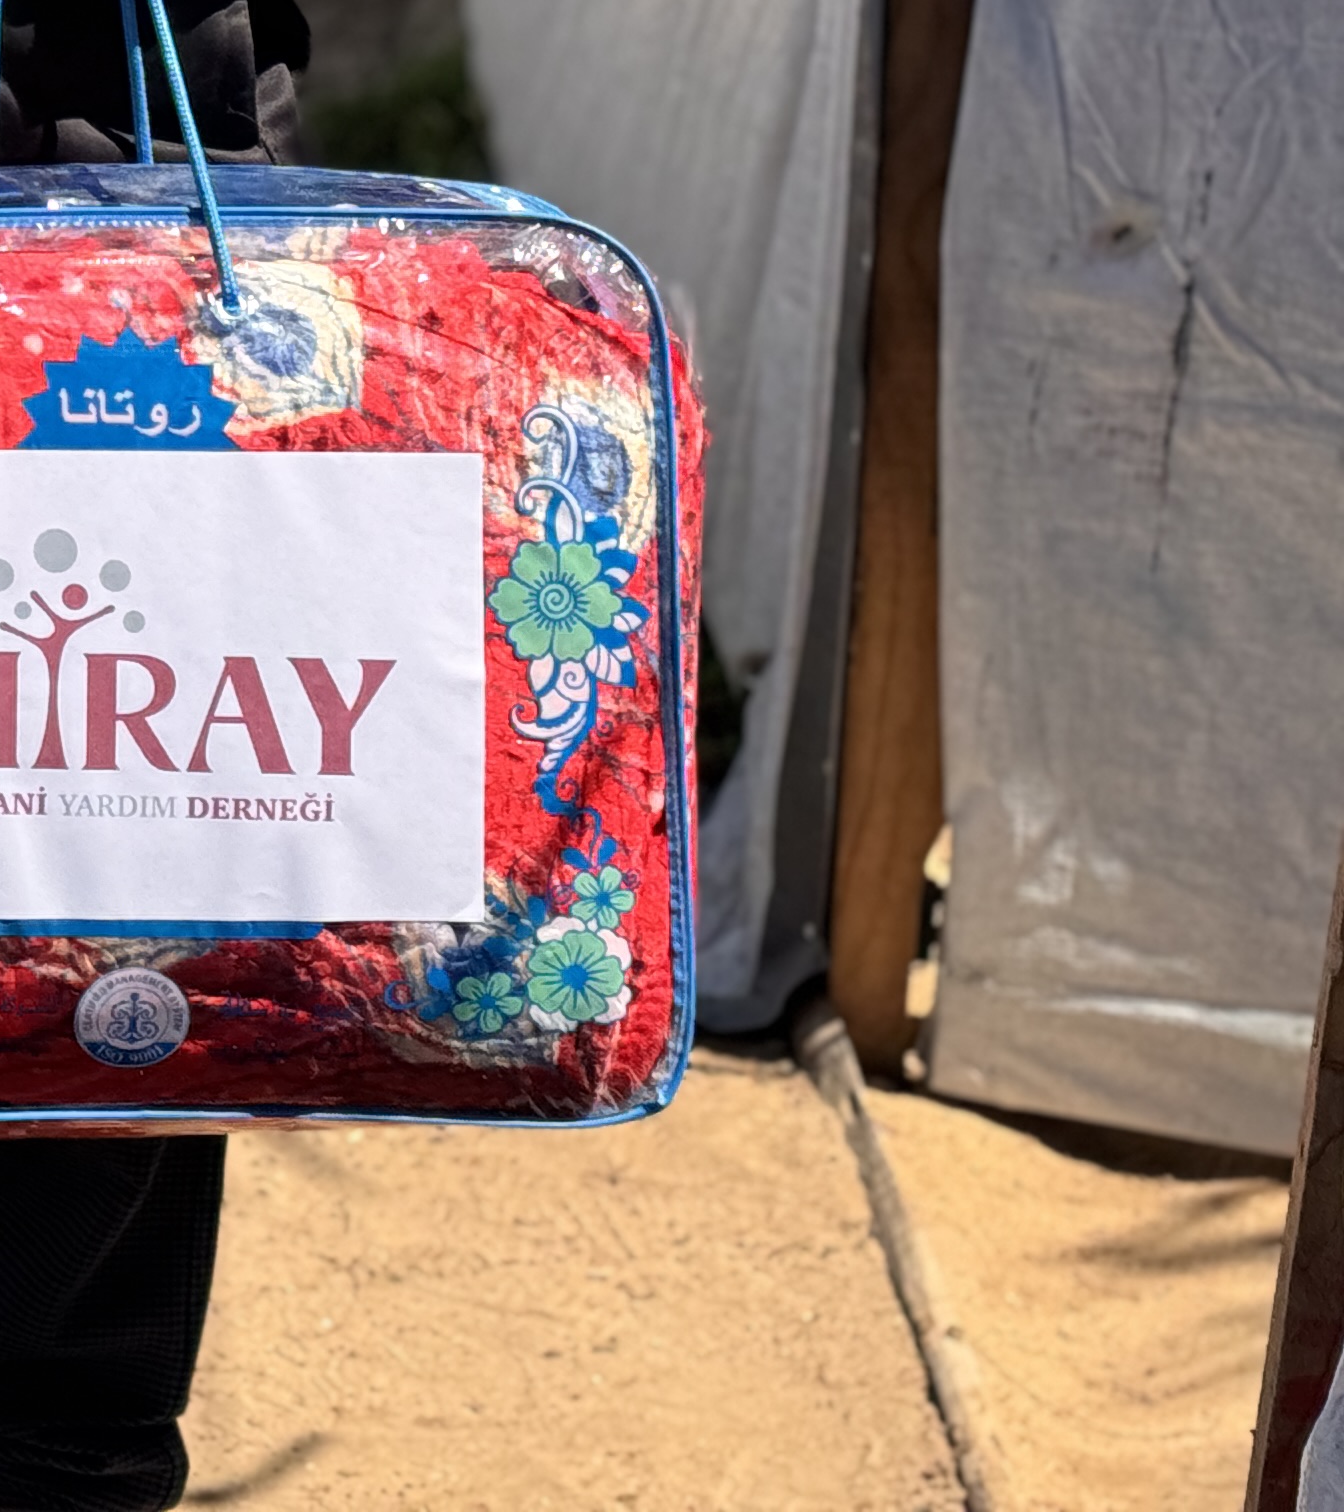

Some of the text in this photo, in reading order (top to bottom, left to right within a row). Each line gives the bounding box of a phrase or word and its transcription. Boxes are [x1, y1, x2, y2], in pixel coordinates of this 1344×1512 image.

[58, 387, 202, 438] روتانا
[58, 792, 179, 819] YARDIM
[185, 791, 336, 823] DERNEĞİ
[96, 1044, 124, 1064] ISO
